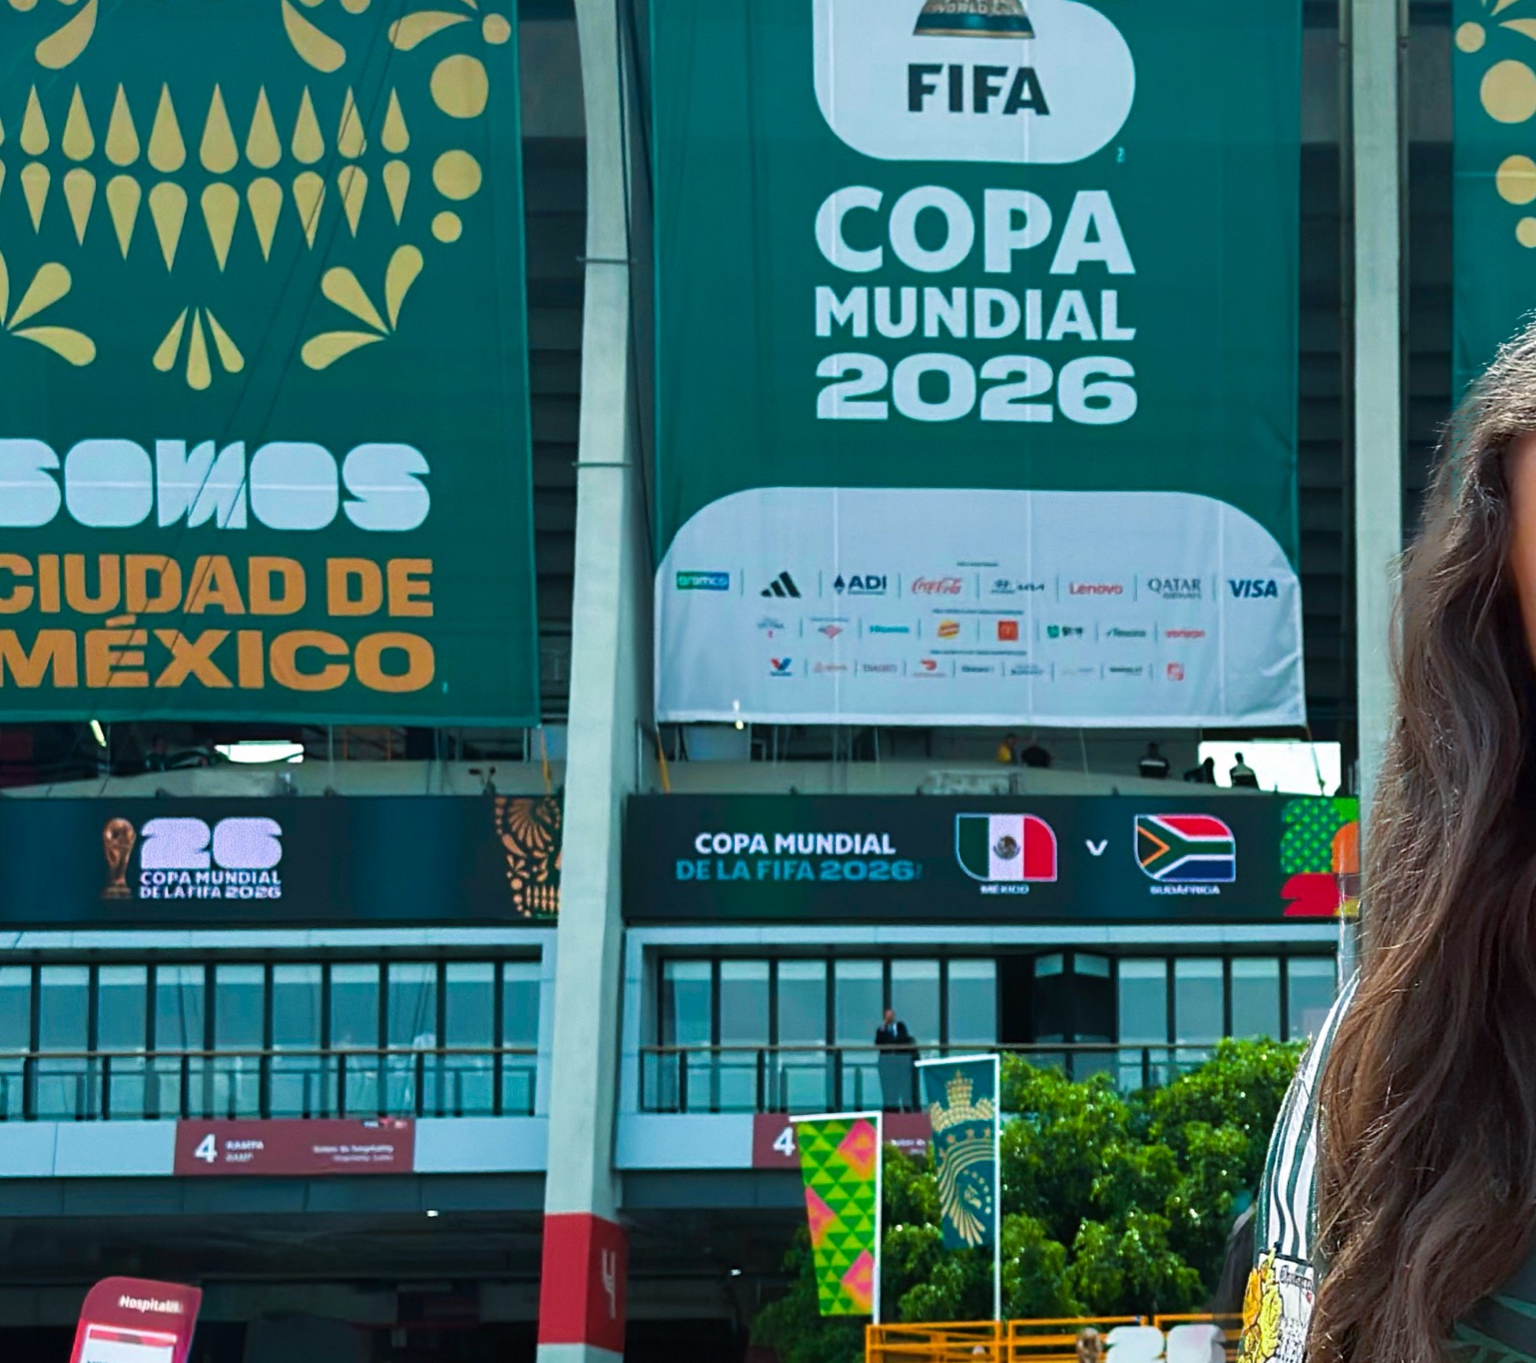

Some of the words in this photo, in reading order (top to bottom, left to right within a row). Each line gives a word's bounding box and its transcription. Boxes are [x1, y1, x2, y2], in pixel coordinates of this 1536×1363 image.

[907, 63, 1051, 116] FIFA
[814, 184, 1137, 275] COPA
[814, 286, 1137, 341] MUNDIAL
[815, 352, 1139, 426] 2026
[0, 438, 431, 532] SOMOS
[0, 553, 307, 616] CIUDAD
[327, 557, 434, 617] DE
[847, 574, 887, 591] ADI
[1069, 582, 1123, 596] Lenovo
[1147, 578, 1201, 593] QATAR
[1227, 579, 1279, 599] VISA
[0, 615, 435, 693] MÉXICO
[695, 833, 768, 855] COPA
[774, 833, 896, 855] MUNDIAL
[140, 871, 191, 885] COPA
[195, 871, 282, 885] MUNDIAL
[676, 860, 711, 881] DE
[716, 859, 750, 881] LA
[757, 859, 815, 881] FIFA
[820, 859, 915, 882] 2026
[140, 887, 159, 899] DE
[225, 887, 281, 899] 2026
[193, 1133, 218, 1164] 4
[772, 1126, 796, 1157] 4
